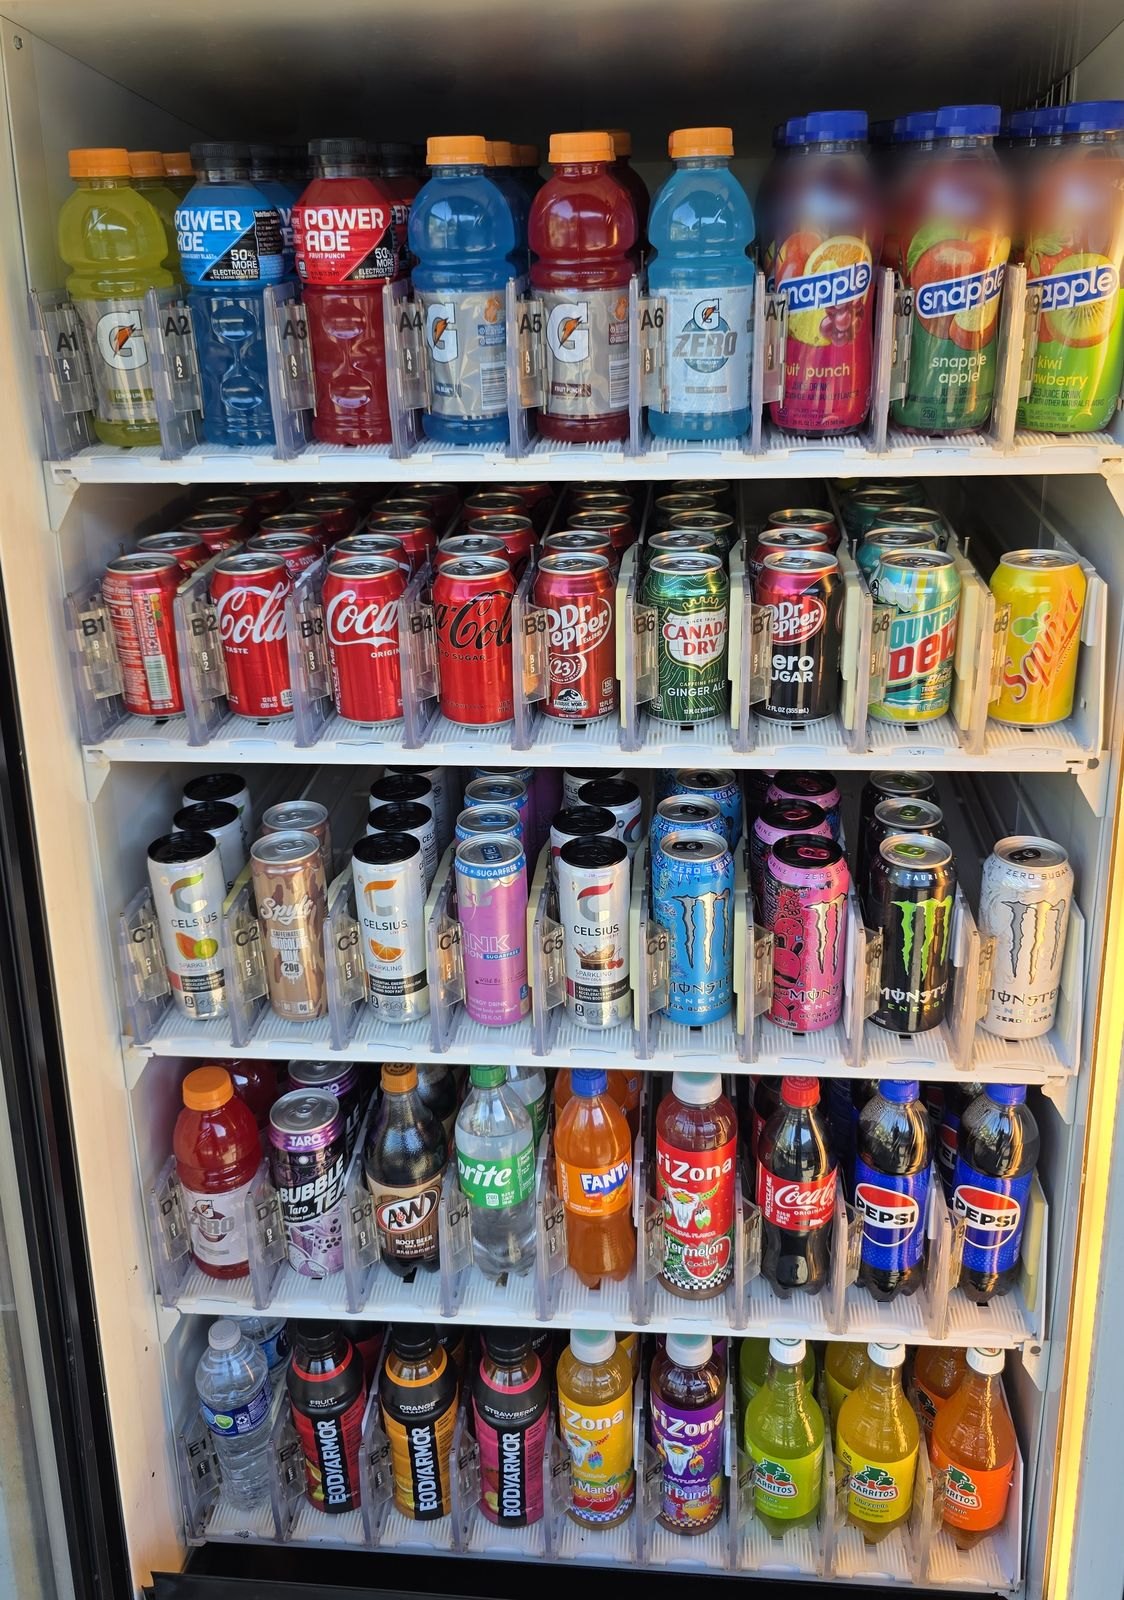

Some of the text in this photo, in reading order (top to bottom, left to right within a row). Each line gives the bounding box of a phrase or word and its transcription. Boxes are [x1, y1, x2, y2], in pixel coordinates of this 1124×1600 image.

[174, 209, 242, 232] POWER
[303, 208, 384, 230] POWER
[305, 230, 351, 252] ADE
[230, 249, 257, 261] 50%
[231, 260, 258, 270] MORE
[376, 259, 395, 268] MORE
[212, 268, 259, 277] ELECTROLYTES
[922, 267, 1005, 311] snapple
[1042, 269, 1115, 311] apple
[640, 307, 664, 331] A6
[764, 299, 786, 321] A7
[164, 315, 191, 337] A2
[282, 320, 308, 340] A3
[400, 311, 423, 333] A4
[519, 313, 542, 335] A5
[56, 331, 79, 352] A1
[671, 331, 738, 358] ZERO
[805, 362, 850, 381] punch
[931, 353, 988, 370] snapple
[1037, 356, 1064, 370] kiwi
[938, 371, 981, 387] apple
[1033, 375, 1089, 391] awberry
[119, 607, 134, 617] 120
[216, 581, 291, 644] Cola
[326, 589, 400, 646] Coca
[560, 604, 592, 630] Dr
[779, 601, 805, 617] Dr
[81, 615, 106, 637] B1
[191, 614, 219, 637] B2
[301, 617, 323, 639] B3
[411, 614, 433, 635] B4
[525, 613, 547, 636] B5
[636, 613, 656, 636] B6
[662, 618, 729, 641] CANADA
[752, 612, 772, 635] B7
[225, 645, 249, 655] TASTE
[370, 648, 401, 659] ORIGIN
[452, 653, 487, 661] SUGAR
[682, 637, 720, 657] DRY
[553, 659, 572, 676] 23
[772, 654, 815, 671] ero
[679, 679, 708, 687] CAFFEINE
[770, 670, 814, 683] UGAR
[666, 680, 727, 697] GINGER ALE
[476, 863, 518, 877] SUGARFREE
[672, 855, 733, 875] ZERO SUGAR
[804, 870, 832, 880] ZERO
[1005, 867, 1069, 881] ZERO SUGAR
[906, 869, 949, 882] TAURINE
[170, 911, 218, 929] CELSIUS
[363, 918, 409, 931] CELSIUS
[573, 923, 620, 937] CELSIUS
[132, 924, 155, 943] C1
[235, 926, 260, 947] C2
[337, 931, 359, 951] C3
[439, 930, 461, 950] C4
[462, 934, 511, 953] INK
[542, 933, 564, 955] C5
[647, 935, 667, 956] C6
[485, 949, 520, 960] SUGARFREE
[283, 962, 301, 974] 20g
[367, 961, 403, 972] SPARKLING
[575, 970, 613, 978] SPARKLING
[879, 981, 948, 1004] MONSTE
[996, 1014, 1023, 1024] ZERO
[289, 1134, 322, 1147] TARO
[457, 1156, 513, 1188] prite
[581, 1161, 630, 1192] FANTA
[658, 1150, 733, 1183] riZona
[279, 1153, 345, 1204] BUBBLE
[313, 1172, 345, 1214] TEA
[161, 1194, 179, 1217] D1
[257, 1199, 280, 1221] D2
[287, 1204, 309, 1216] Taro
[351, 1202, 373, 1225] D3
[387, 1192, 426, 1231] A&W
[793, 1207, 826, 1217] ORIGINAL
[856, 1195, 916, 1226] PEPSI
[954, 1197, 1017, 1228] PEPSI
[448, 1204, 470, 1228] D4
[645, 1214, 664, 1234] D6
[395, 1238, 415, 1246] ROOT
[309, 1397, 336, 1406] FRUIT
[399, 1400, 437, 1412] ORANGE
[483, 1404, 539, 1418] STRAWBERRY
[652, 1405, 724, 1439] riZona
[188, 1438, 207, 1458] E1
[369, 1445, 391, 1466] E3
[458, 1451, 477, 1470] E4
[552, 1459, 572, 1479] E5
[578, 1482, 621, 1496] Mango
[675, 1486, 714, 1502] Punch
[755, 1476, 793, 1494] ARRITOS
[850, 1481, 895, 1497] JARRITOS
